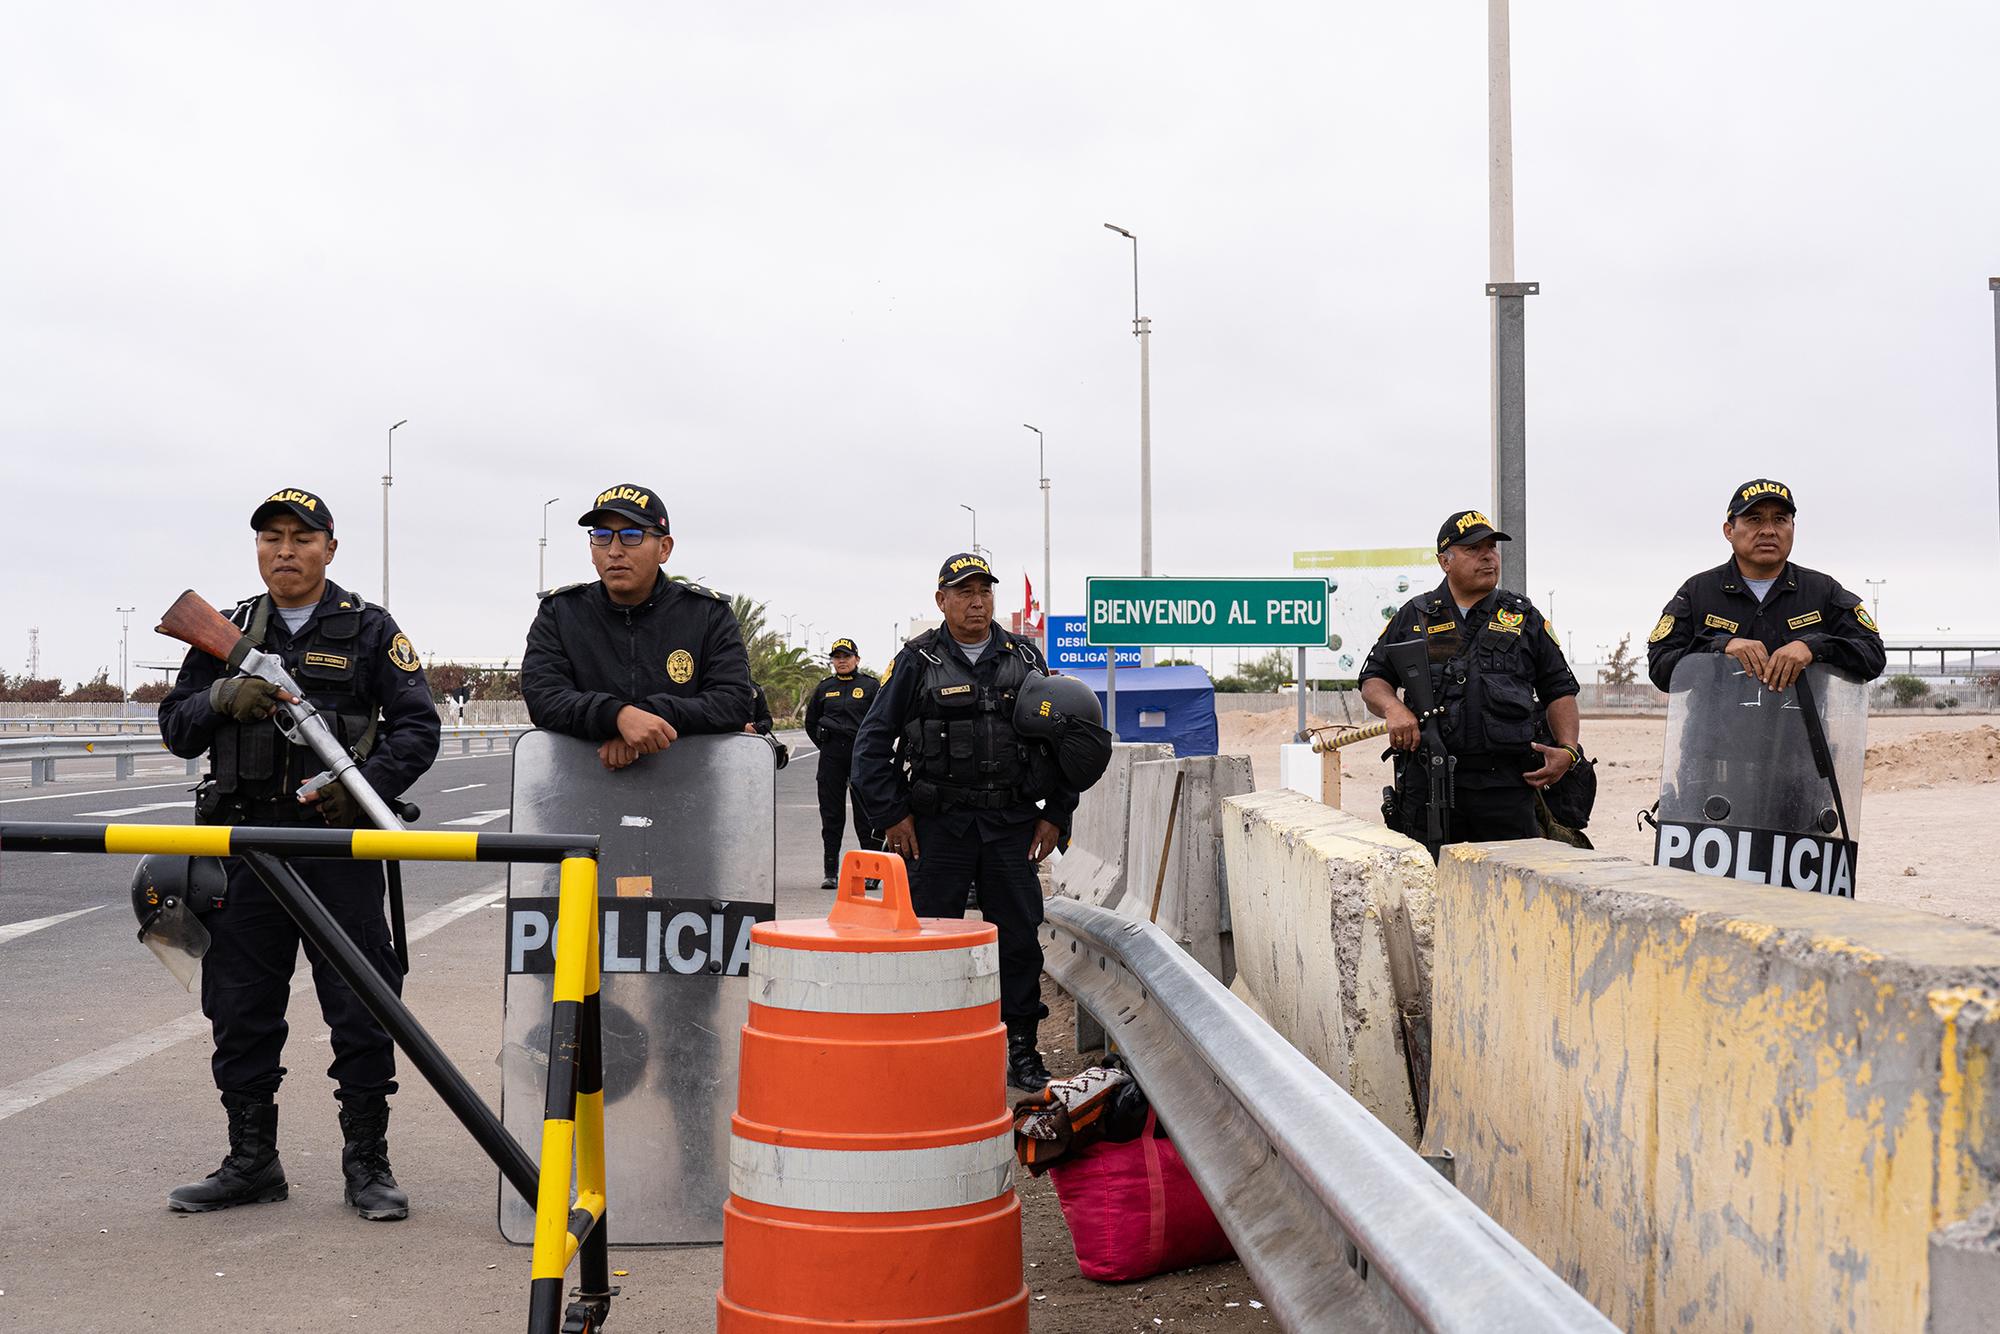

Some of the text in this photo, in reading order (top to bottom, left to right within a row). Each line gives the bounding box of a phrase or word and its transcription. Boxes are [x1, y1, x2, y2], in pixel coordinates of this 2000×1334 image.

[265, 489, 318, 512] OLICIA
[597, 486, 650, 510] POLICIA
[1742, 483, 1789, 501] POLICIA
[1093, 599, 1322, 625] BIENVENIDO AL PERU
[1658, 824, 1853, 900] POLICIA
